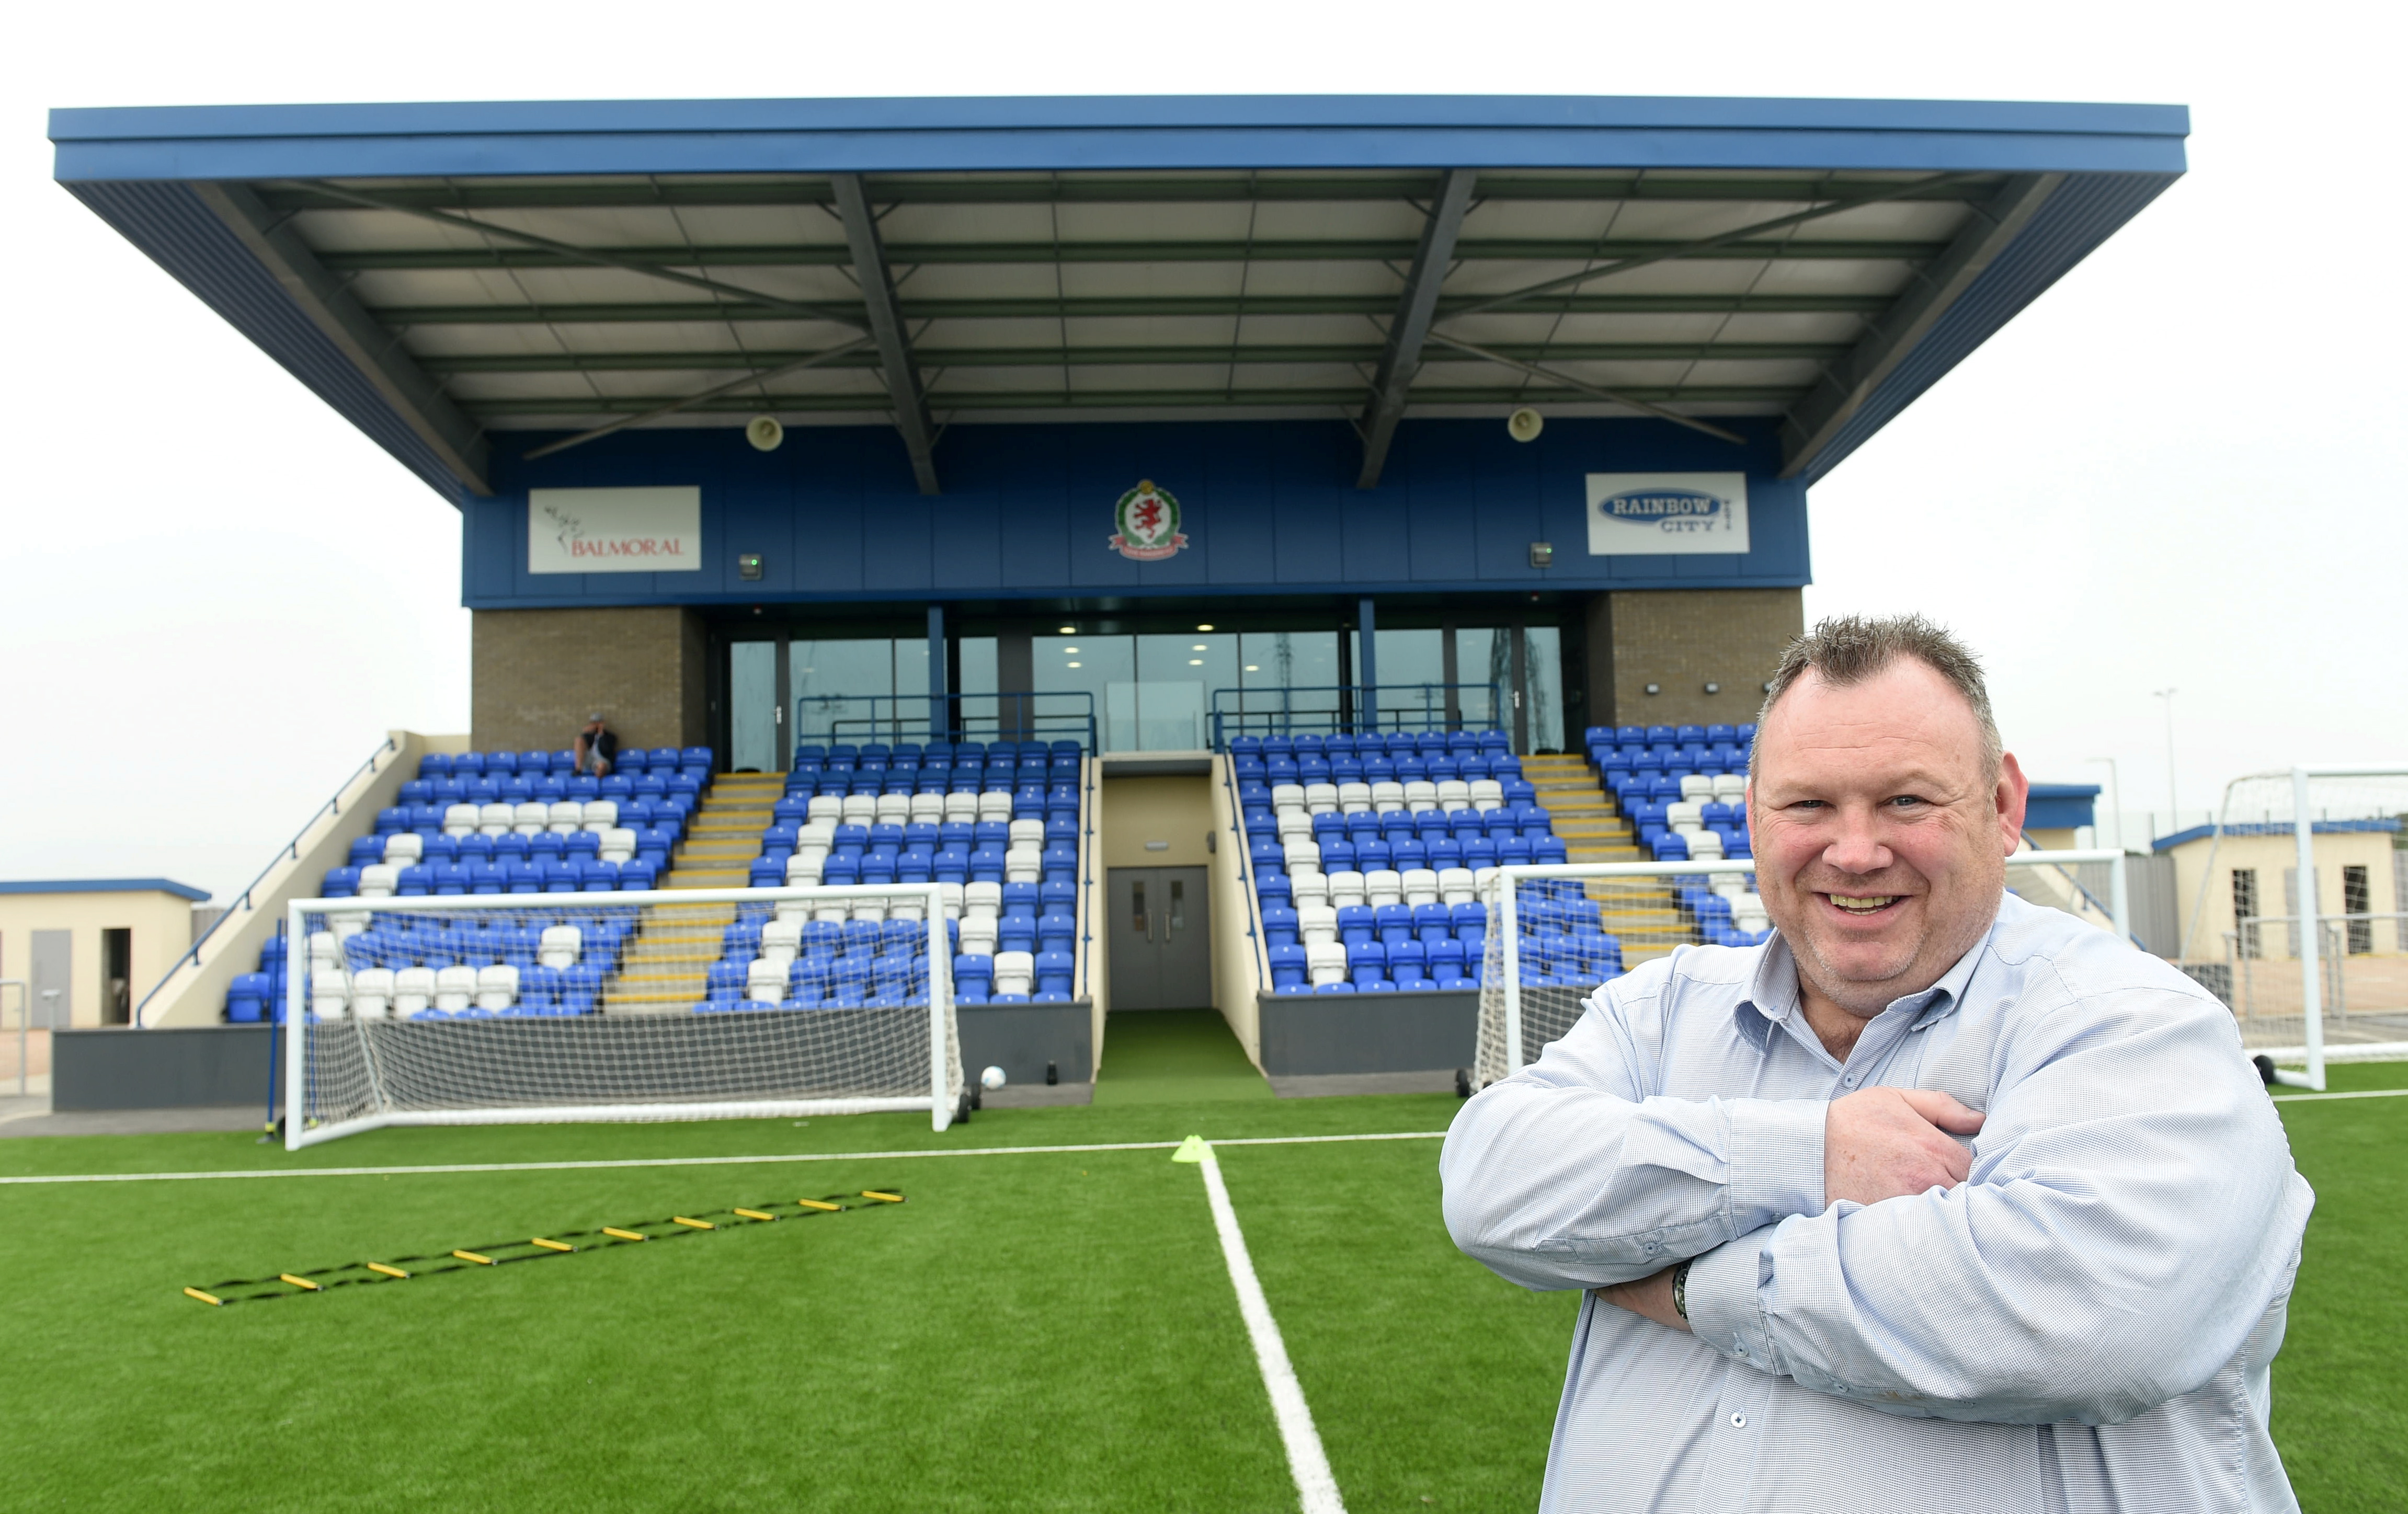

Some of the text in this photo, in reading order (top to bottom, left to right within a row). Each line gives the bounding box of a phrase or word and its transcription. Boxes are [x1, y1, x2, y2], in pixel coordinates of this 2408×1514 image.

[1614, 499, 1709, 514] RAINBOW
[1662, 520, 1714, 532] CITY
[572, 539, 683, 556] BALMORAL
